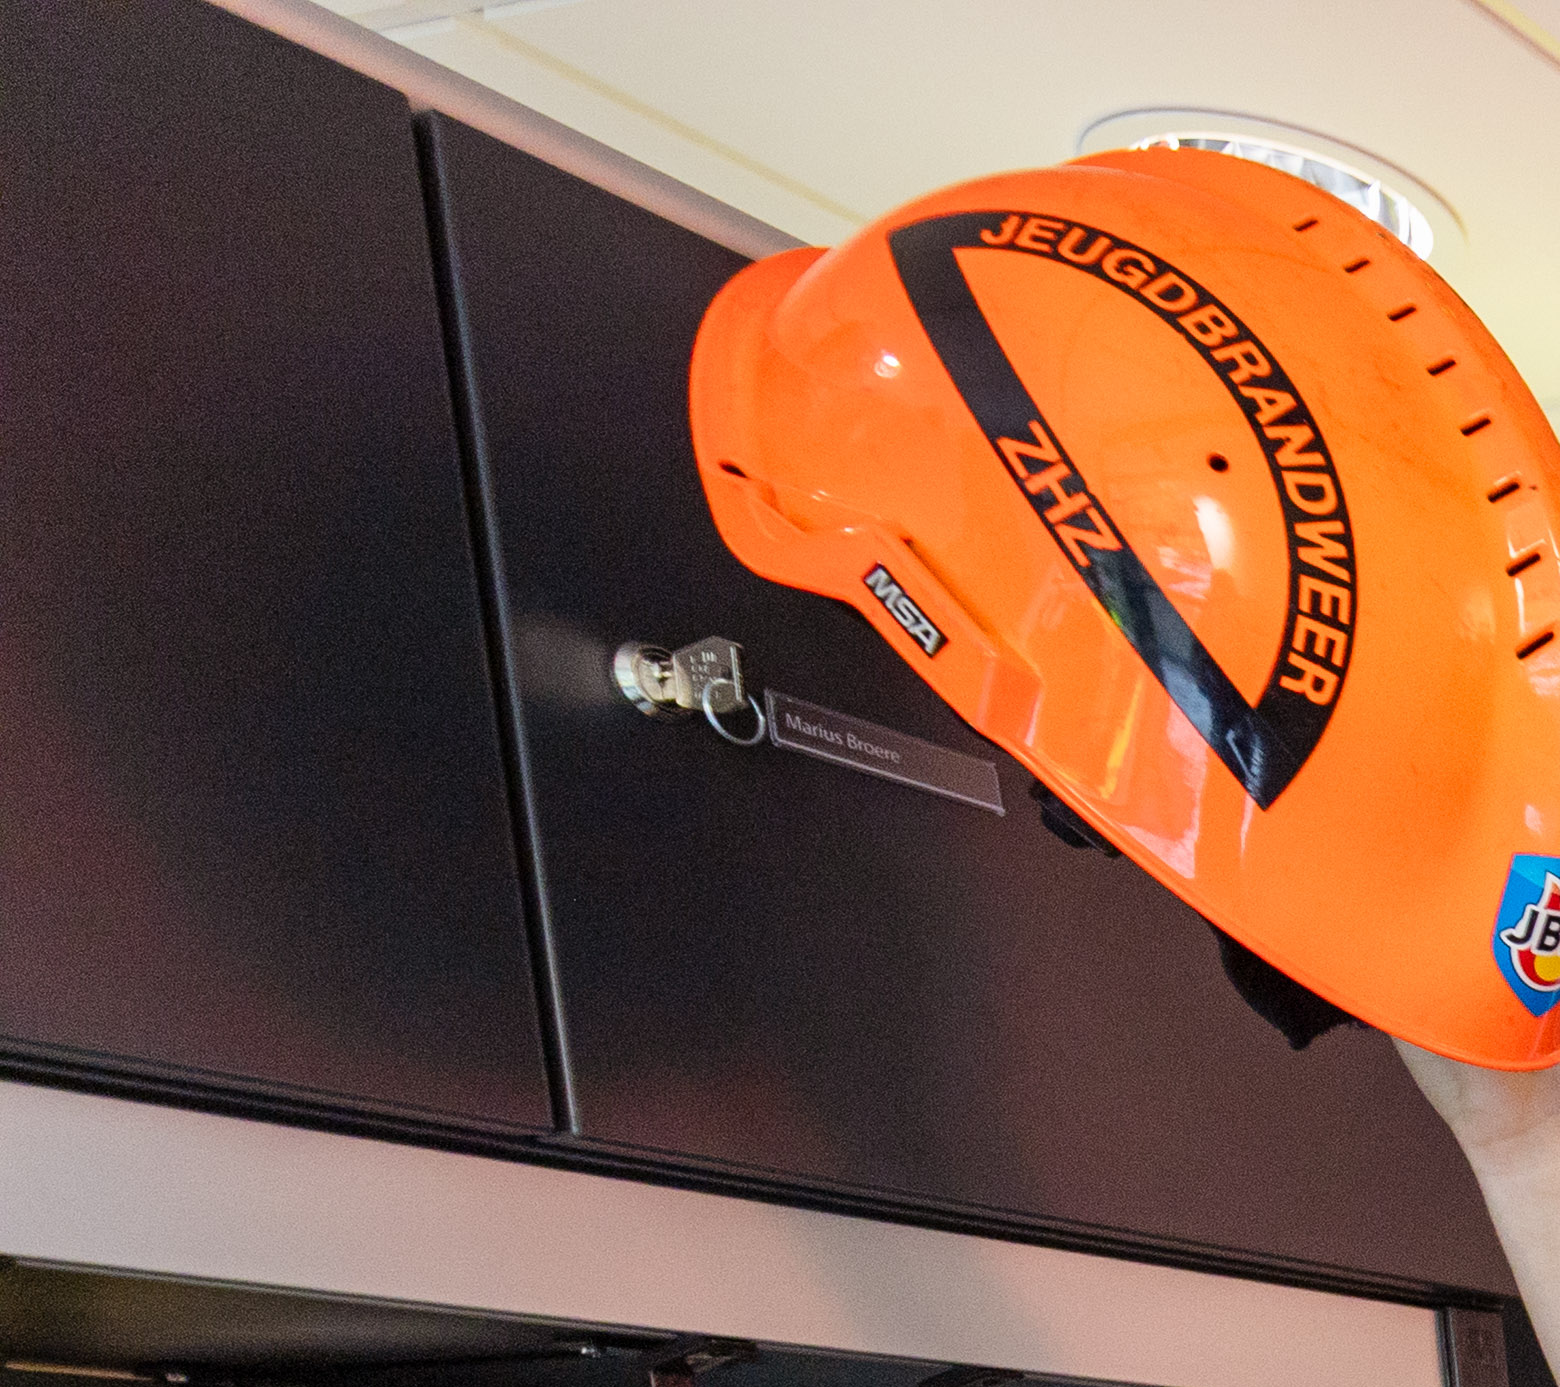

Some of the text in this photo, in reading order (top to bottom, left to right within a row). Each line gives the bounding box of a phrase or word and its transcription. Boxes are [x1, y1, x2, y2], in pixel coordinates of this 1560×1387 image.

[980, 215, 1351, 706] JEUGDBRANDWEER
[997, 420, 1123, 568] ZHZ
[864, 567, 941, 655] MSA
[785, 712, 900, 763] Marius Broere
